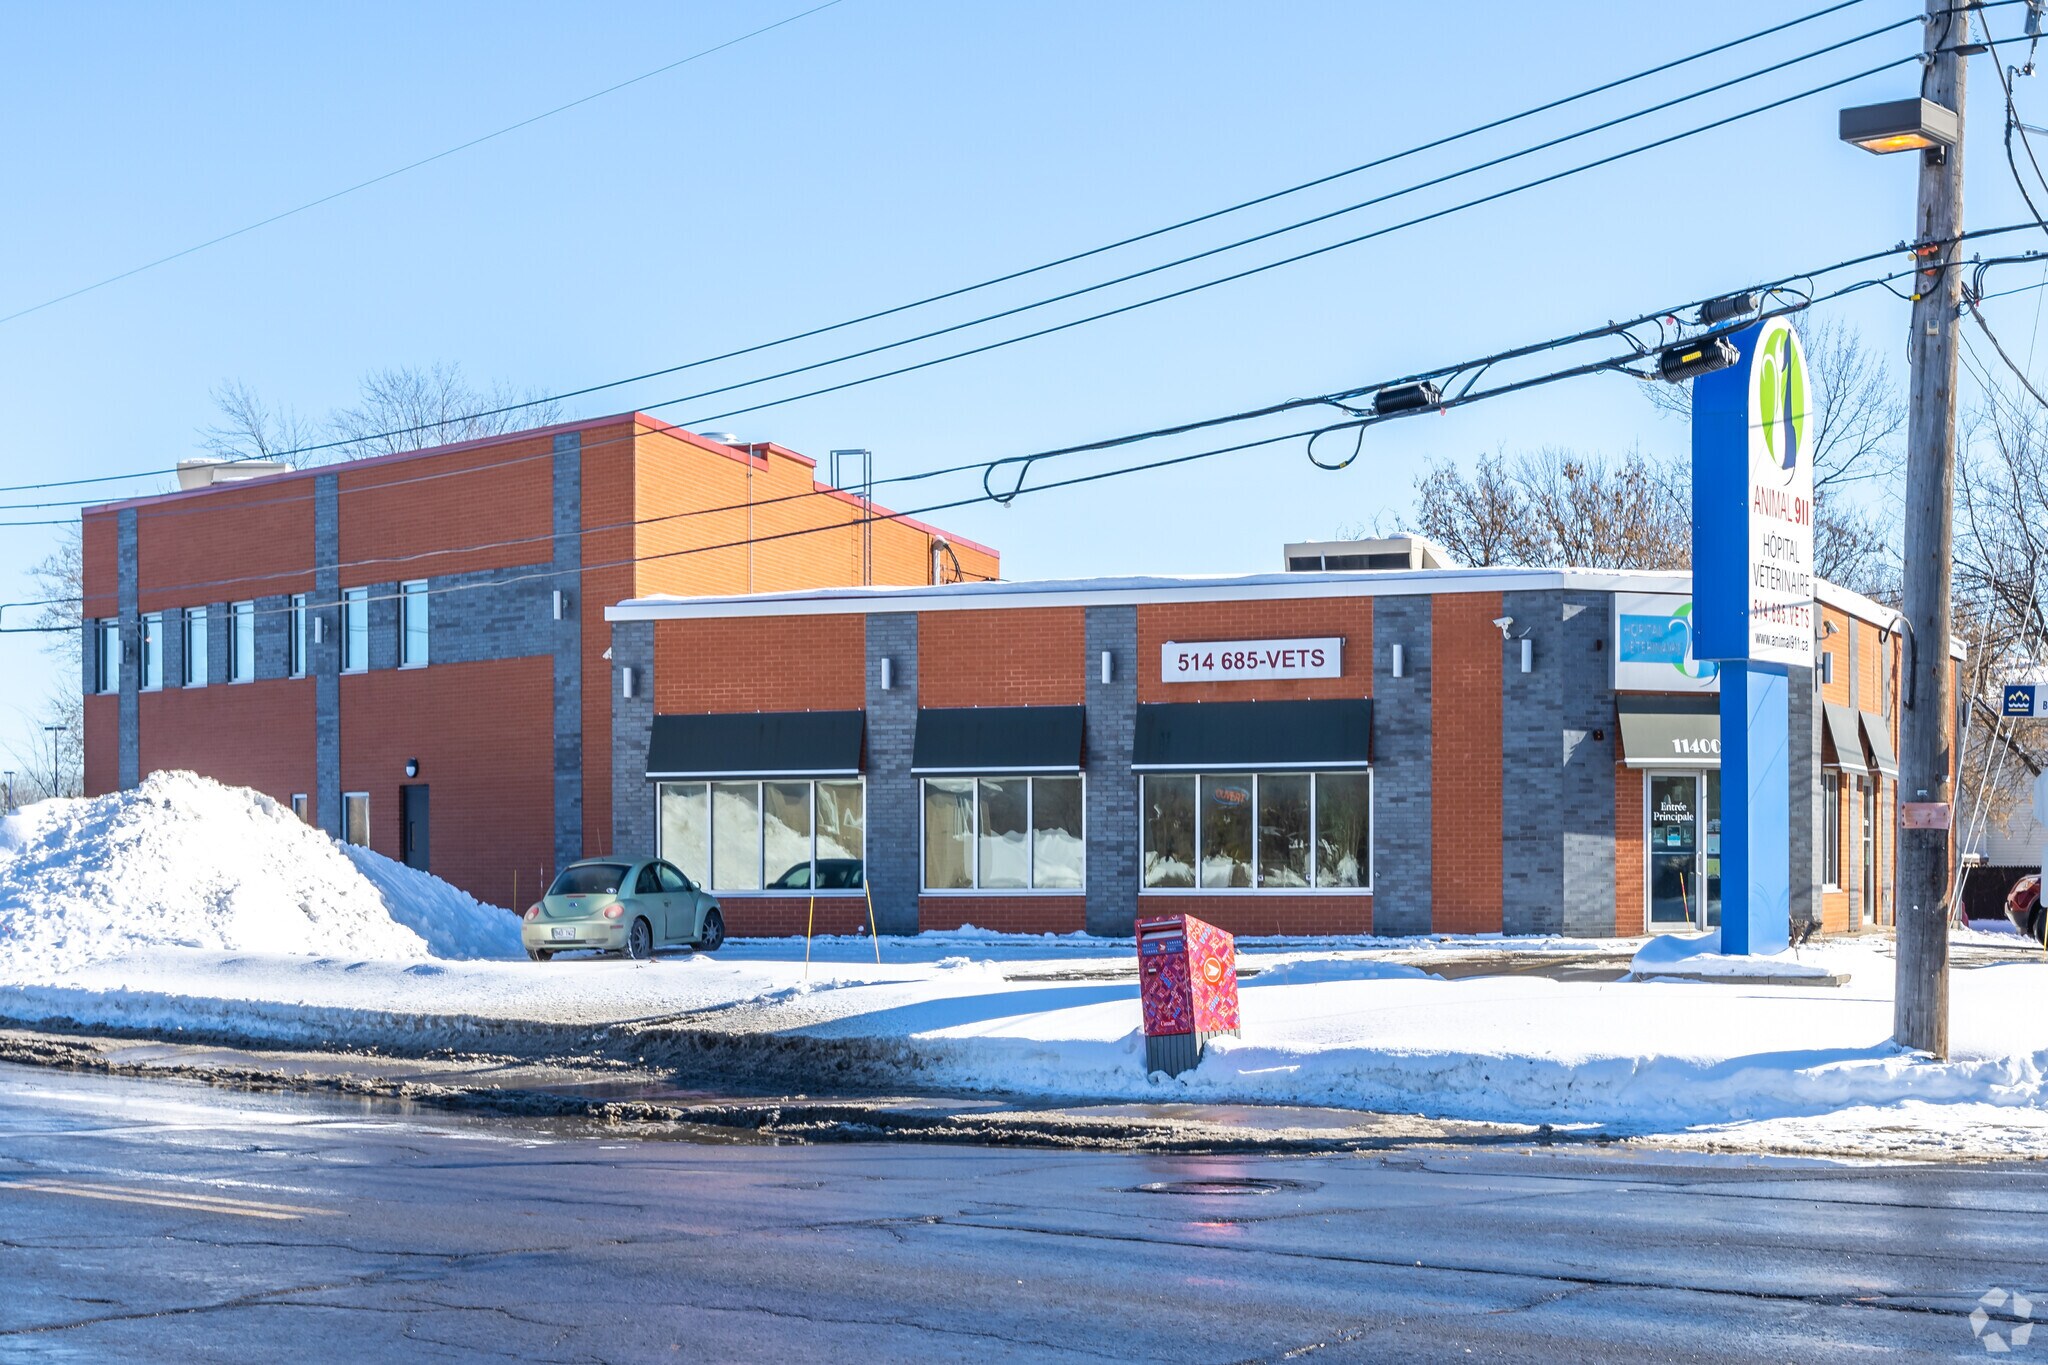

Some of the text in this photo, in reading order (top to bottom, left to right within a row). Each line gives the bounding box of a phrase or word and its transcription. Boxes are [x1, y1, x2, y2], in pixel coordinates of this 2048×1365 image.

[1754, 484, 1808, 526] ANIMAL 911
[1763, 530, 1800, 564] HÔPITAL
[1753, 560, 1809, 597] VÉTÉRINAIRE
[1755, 632, 1808, 651] www.animal911.ca
[1178, 649, 1325, 671] 514 685-VETS
[1672, 738, 1721, 754] 11400
[1660, 801, 1687, 812] Entrée
[1653, 811, 1694, 824] Principale
